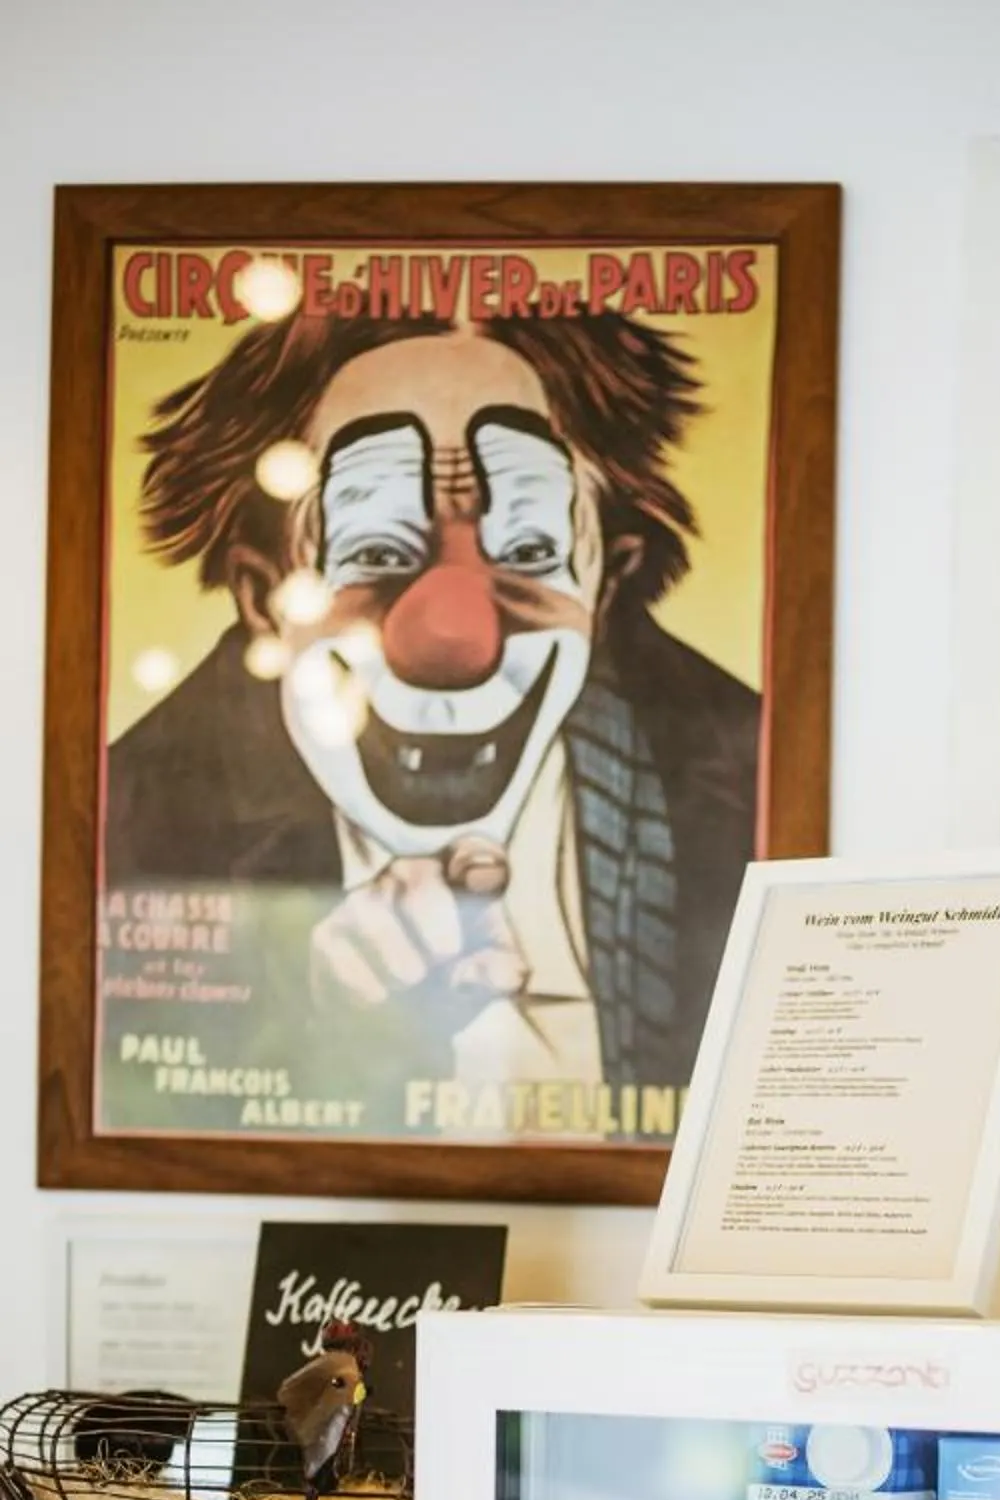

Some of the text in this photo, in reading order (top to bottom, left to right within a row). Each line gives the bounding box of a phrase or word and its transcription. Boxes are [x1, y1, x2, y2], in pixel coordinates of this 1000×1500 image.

[587, 250, 758, 315] PARIS
[120, 1032, 206, 1065] PAUL
[241, 1097, 366, 1128] ALBERT
